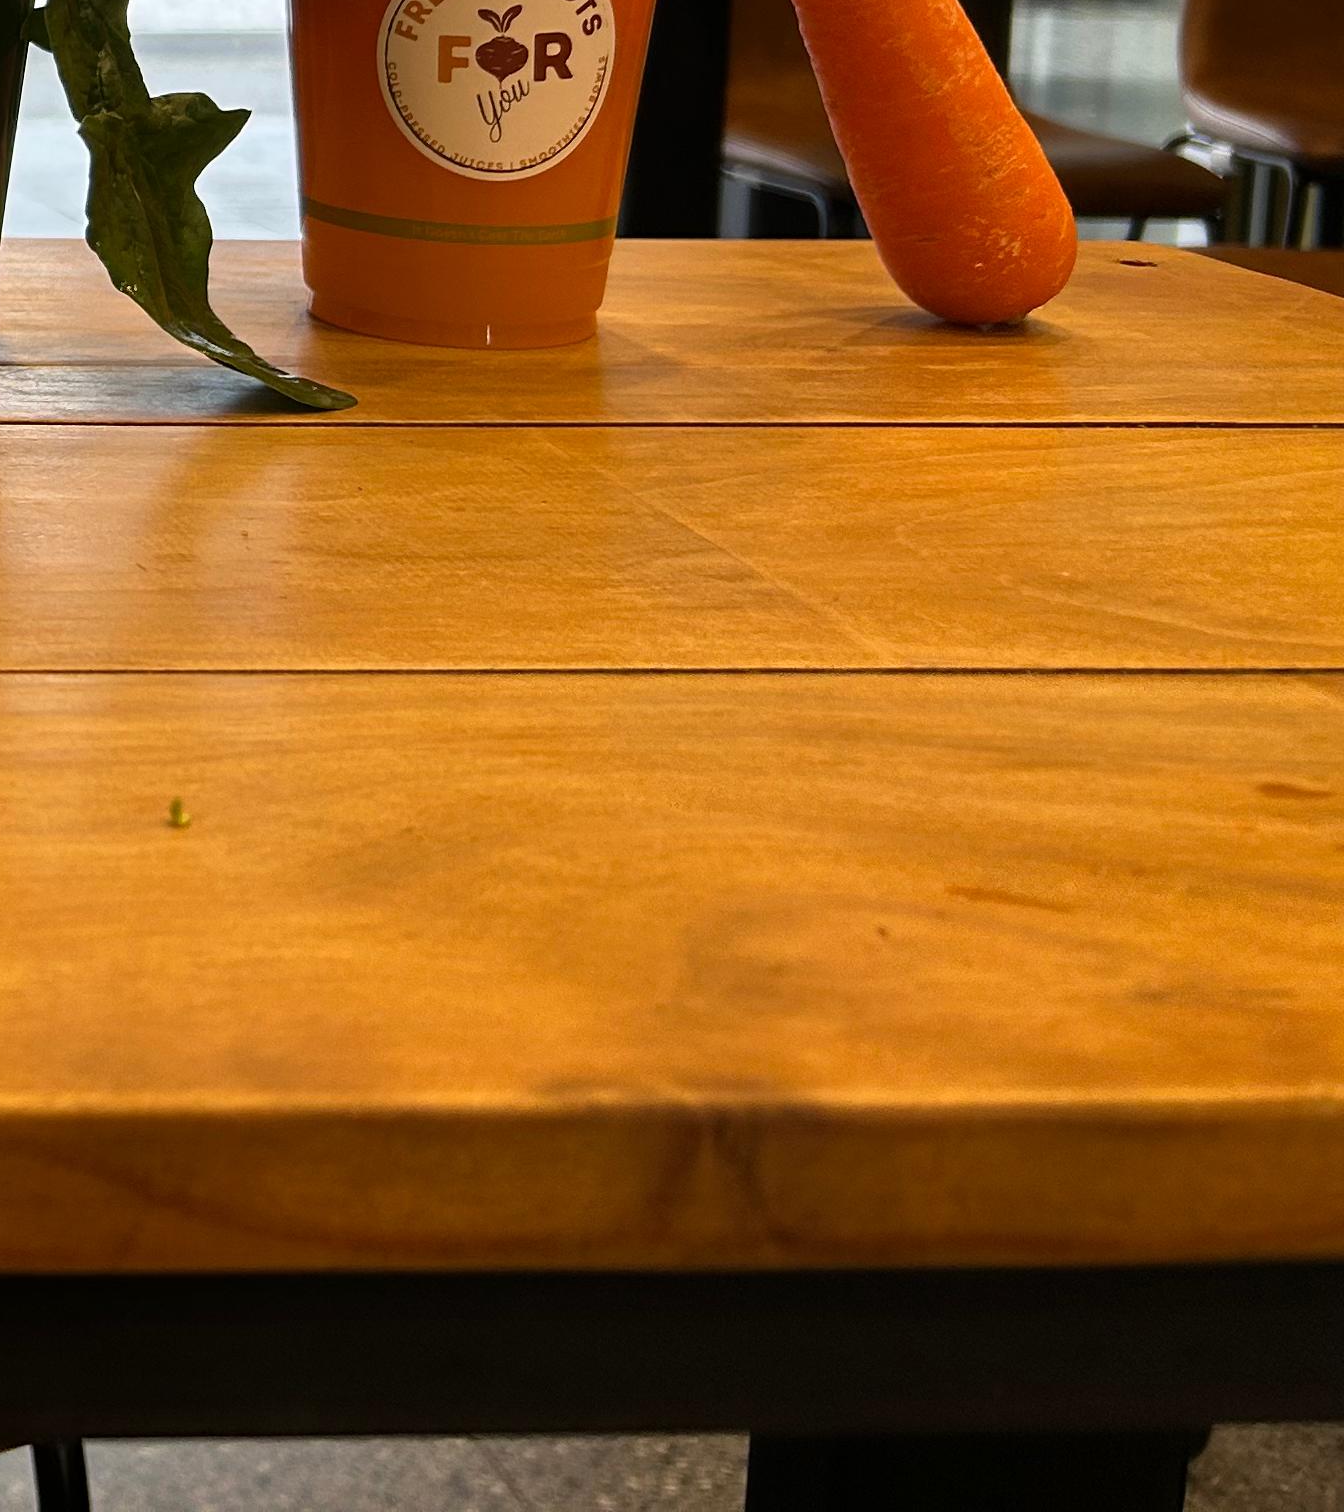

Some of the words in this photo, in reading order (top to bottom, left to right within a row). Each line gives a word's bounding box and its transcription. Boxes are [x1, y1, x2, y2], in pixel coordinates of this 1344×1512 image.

[476, 79, 530, 144] You
[518, 115, 587, 170] SMOOTHIES
[590, 55, 608, 102] BOWLS
